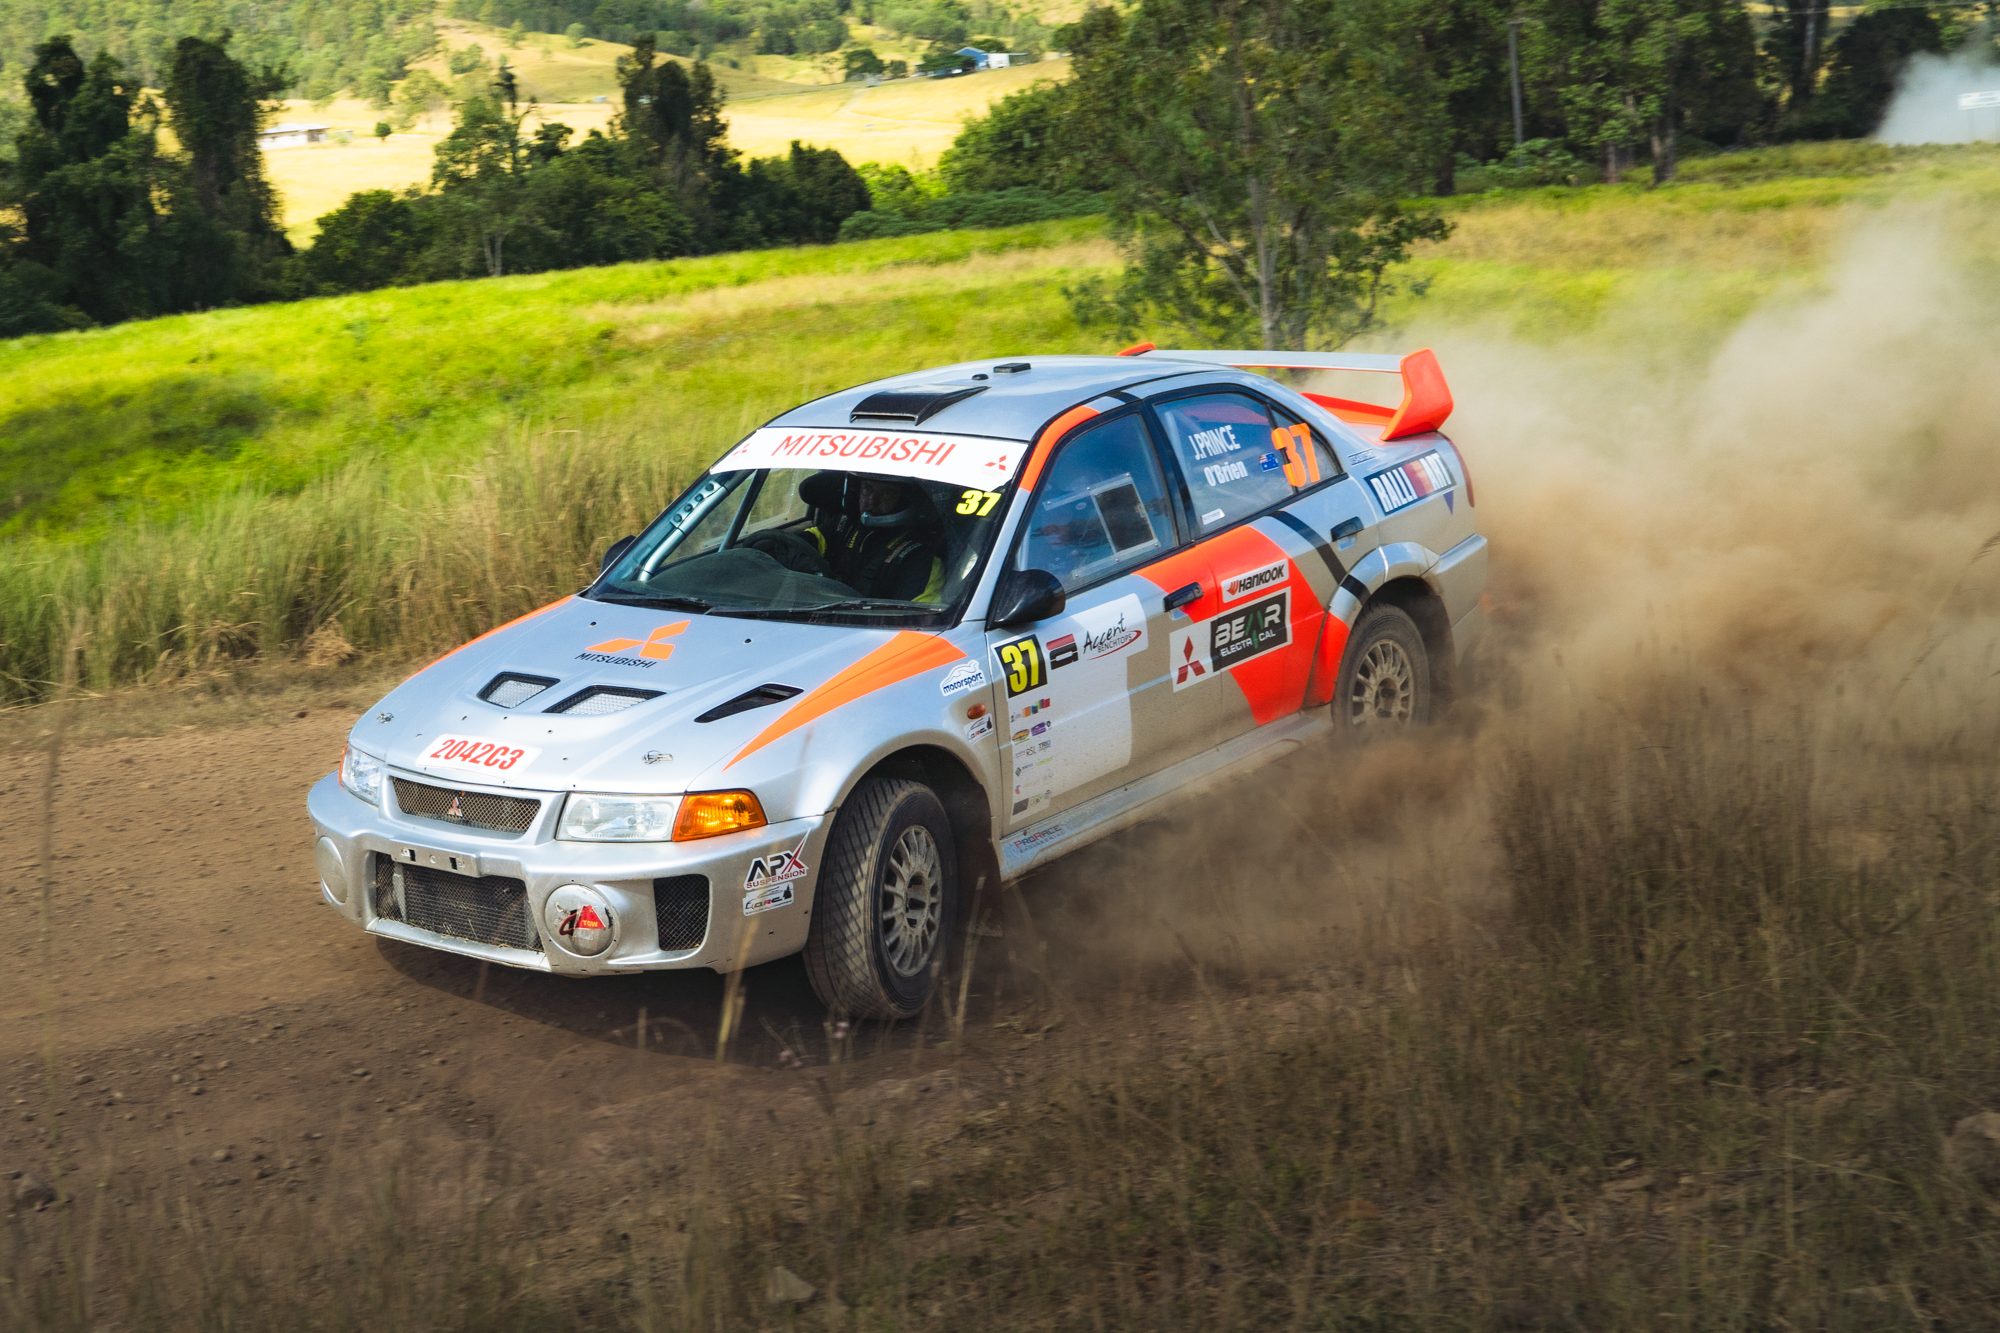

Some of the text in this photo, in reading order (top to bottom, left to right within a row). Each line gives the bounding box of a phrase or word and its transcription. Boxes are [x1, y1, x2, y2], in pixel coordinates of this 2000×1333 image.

[770, 435, 957, 466] MITSUBISHI
[1270, 422, 1321, 488] 37
[1203, 460, 1248, 486] O'Brien
[956, 490, 1002, 517] 37
[1083, 612, 1127, 655] Accent
[1097, 633, 1132, 653] BENCHTOPS
[574, 652, 657, 669] MITSUBISHI
[1001, 638, 1039, 694] 37
[943, 672, 983, 694] motorsport
[429, 738, 525, 771] 2042C3
[747, 838, 806, 883] APX
[746, 868, 806, 889] SUSPENSION
